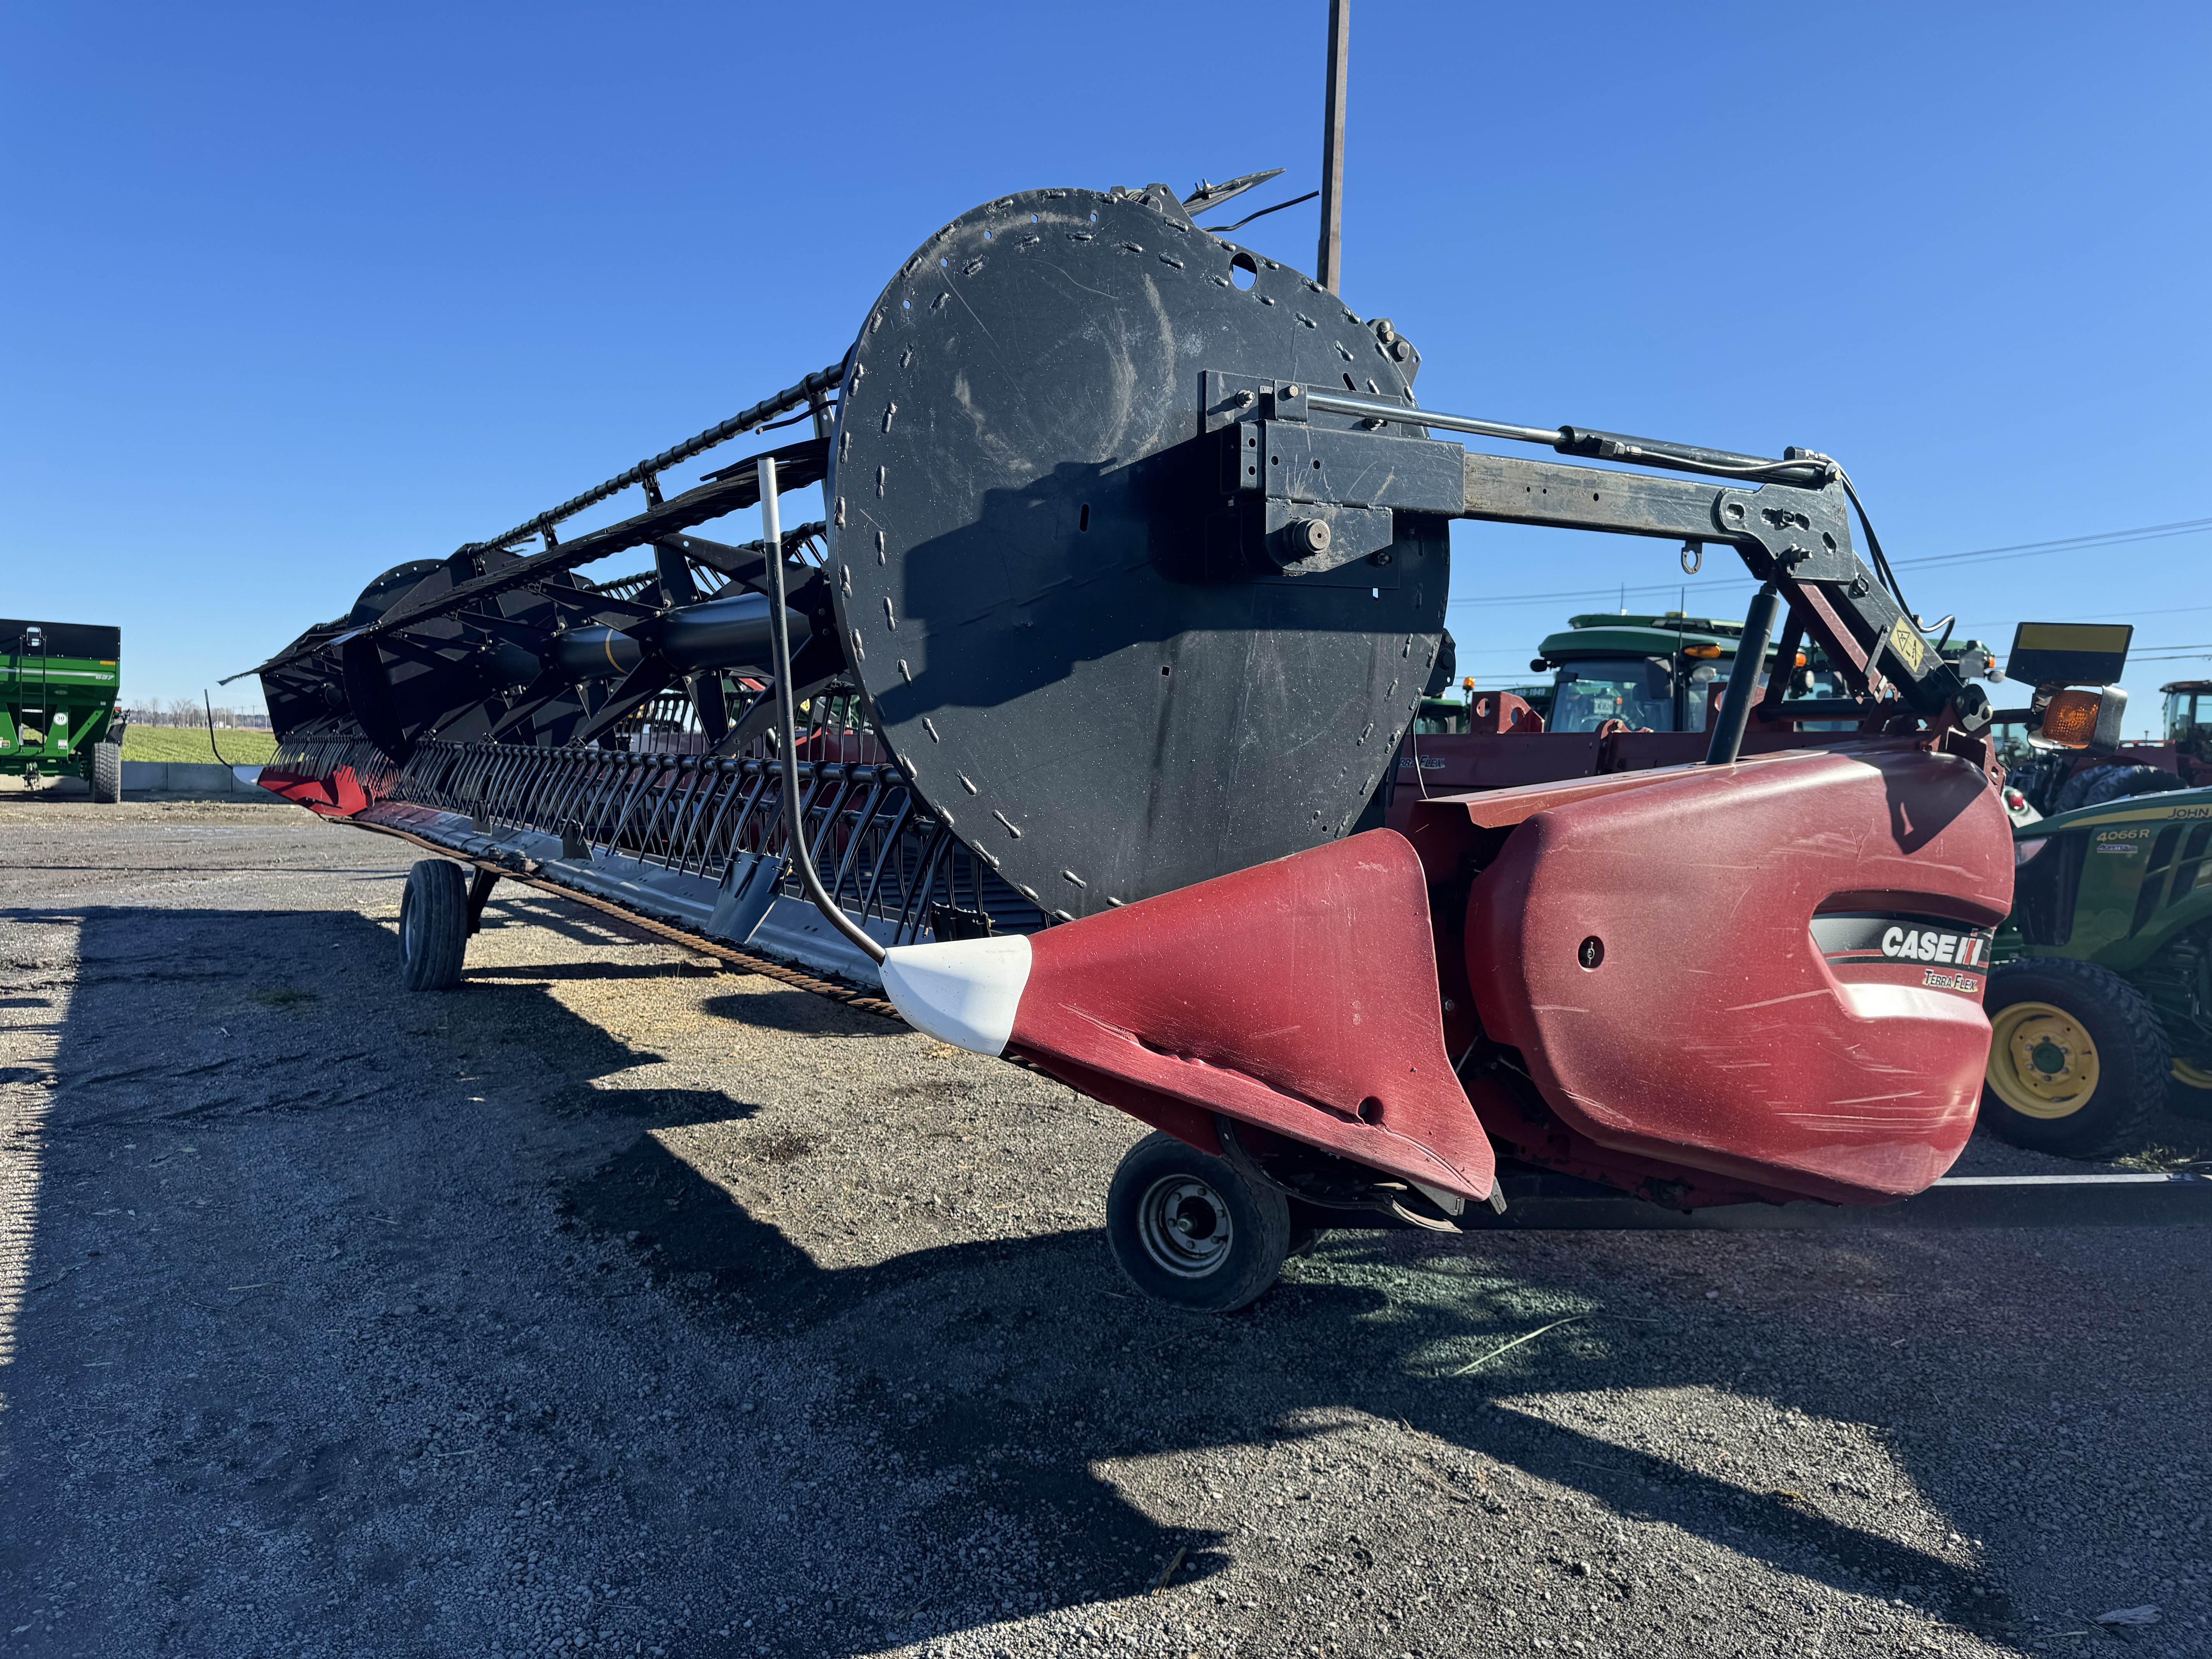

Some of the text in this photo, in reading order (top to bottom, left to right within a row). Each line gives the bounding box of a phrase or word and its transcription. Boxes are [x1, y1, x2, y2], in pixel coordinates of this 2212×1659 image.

[1419, 756, 1444, 768] FLEX
[2167, 808, 2209, 818] JOHN
[1882, 926, 1957, 963] CASE
[1925, 970, 1976, 991] TERRA FLEX
